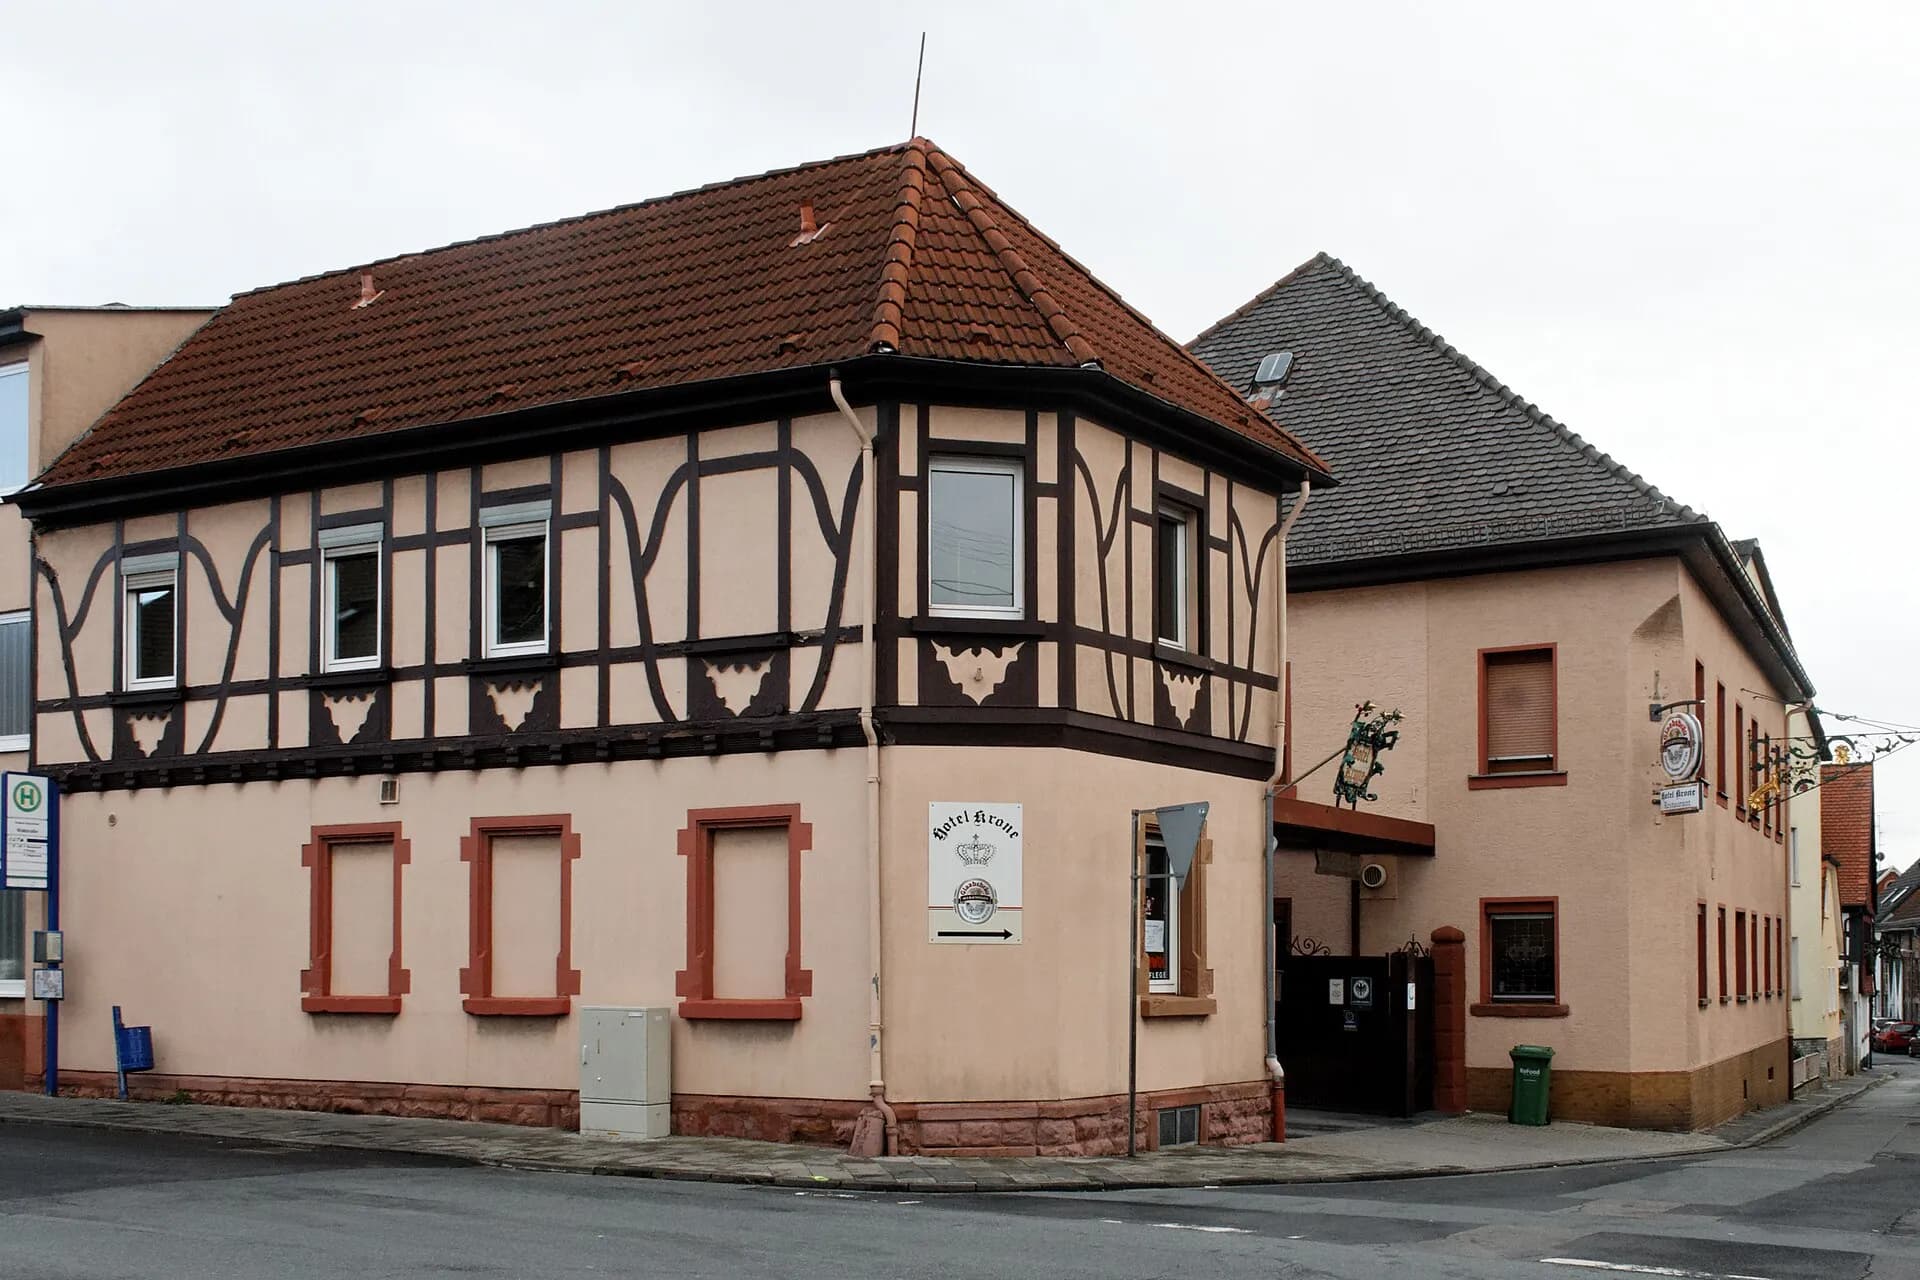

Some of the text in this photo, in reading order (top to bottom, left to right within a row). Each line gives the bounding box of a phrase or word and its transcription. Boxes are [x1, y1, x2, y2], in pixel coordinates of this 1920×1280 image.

[20, 787, 34, 805] H
[1676, 789, 1696, 798] Krone
[932, 810, 1019, 841] Hotel Krone
